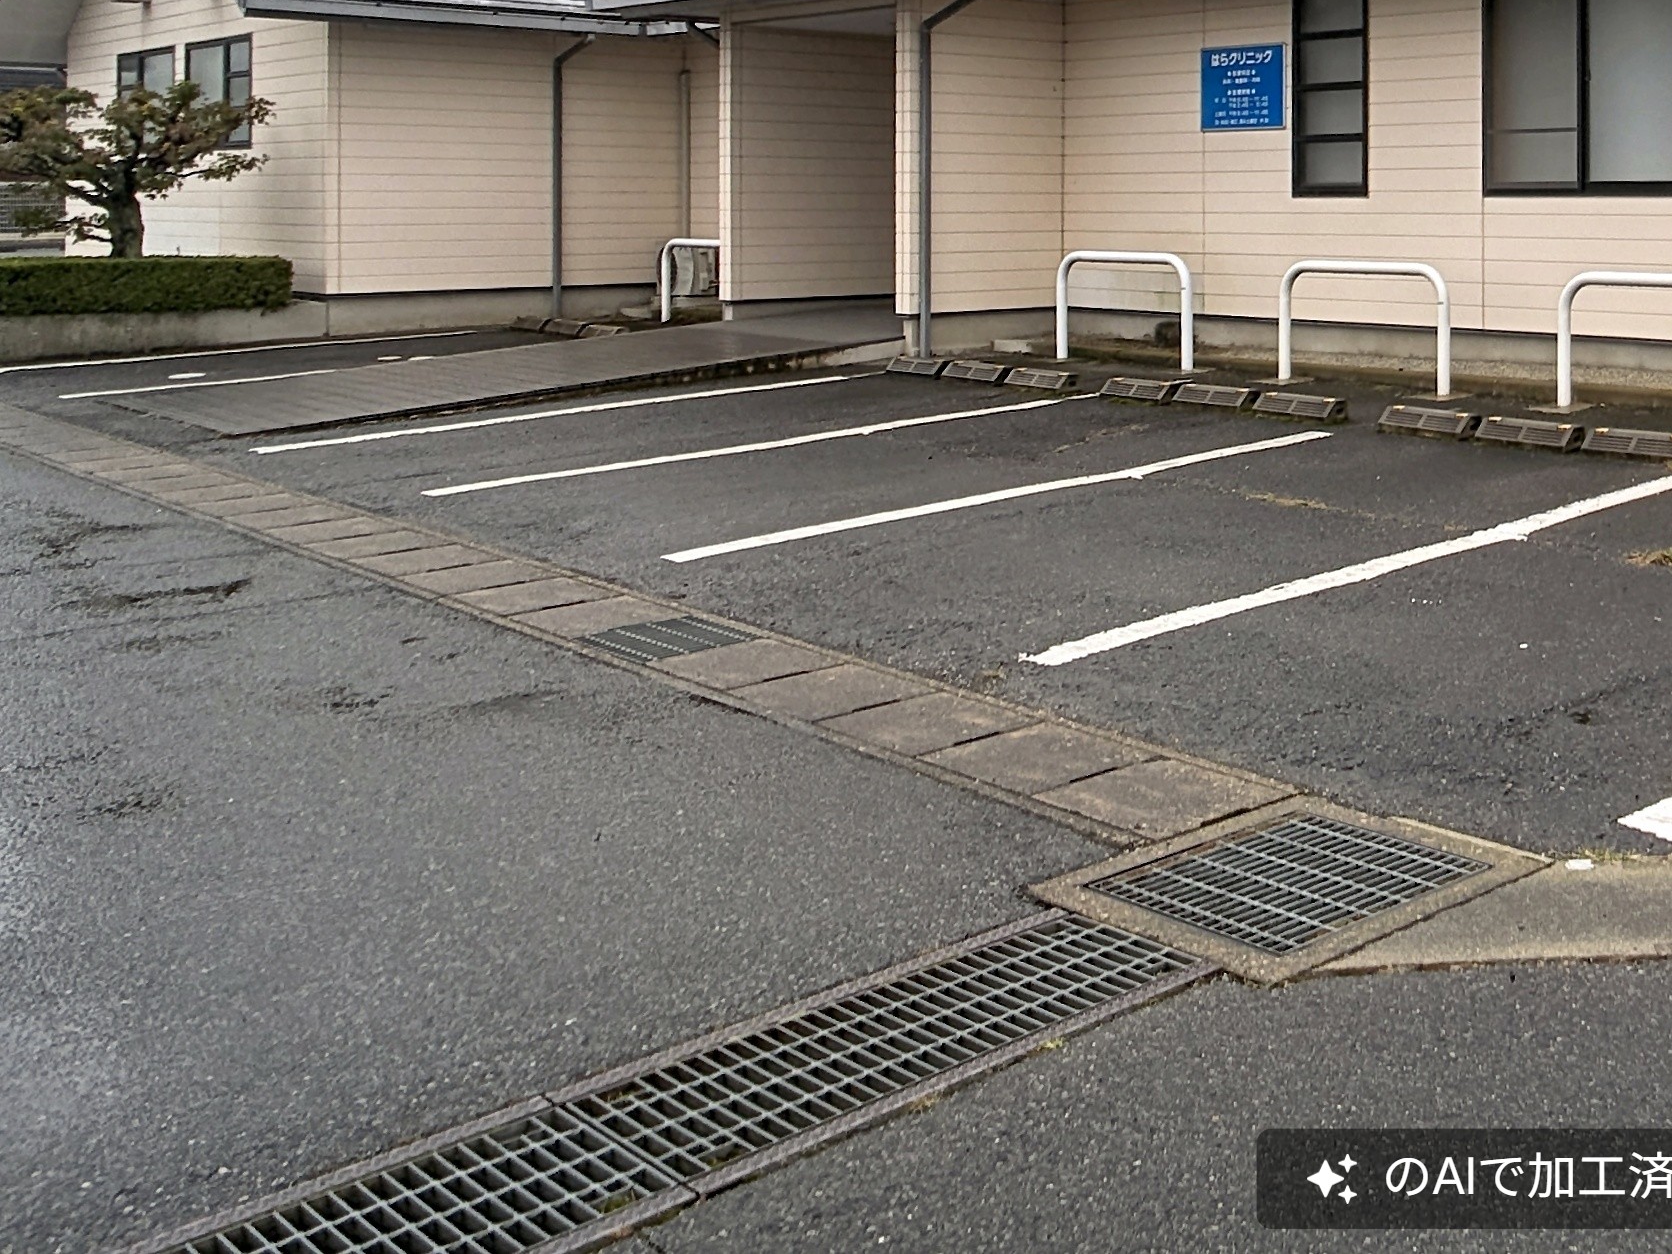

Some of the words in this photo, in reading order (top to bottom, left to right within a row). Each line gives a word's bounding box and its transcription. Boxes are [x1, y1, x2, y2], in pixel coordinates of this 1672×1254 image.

[1211, 50, 1272, 67] はらクリニック
